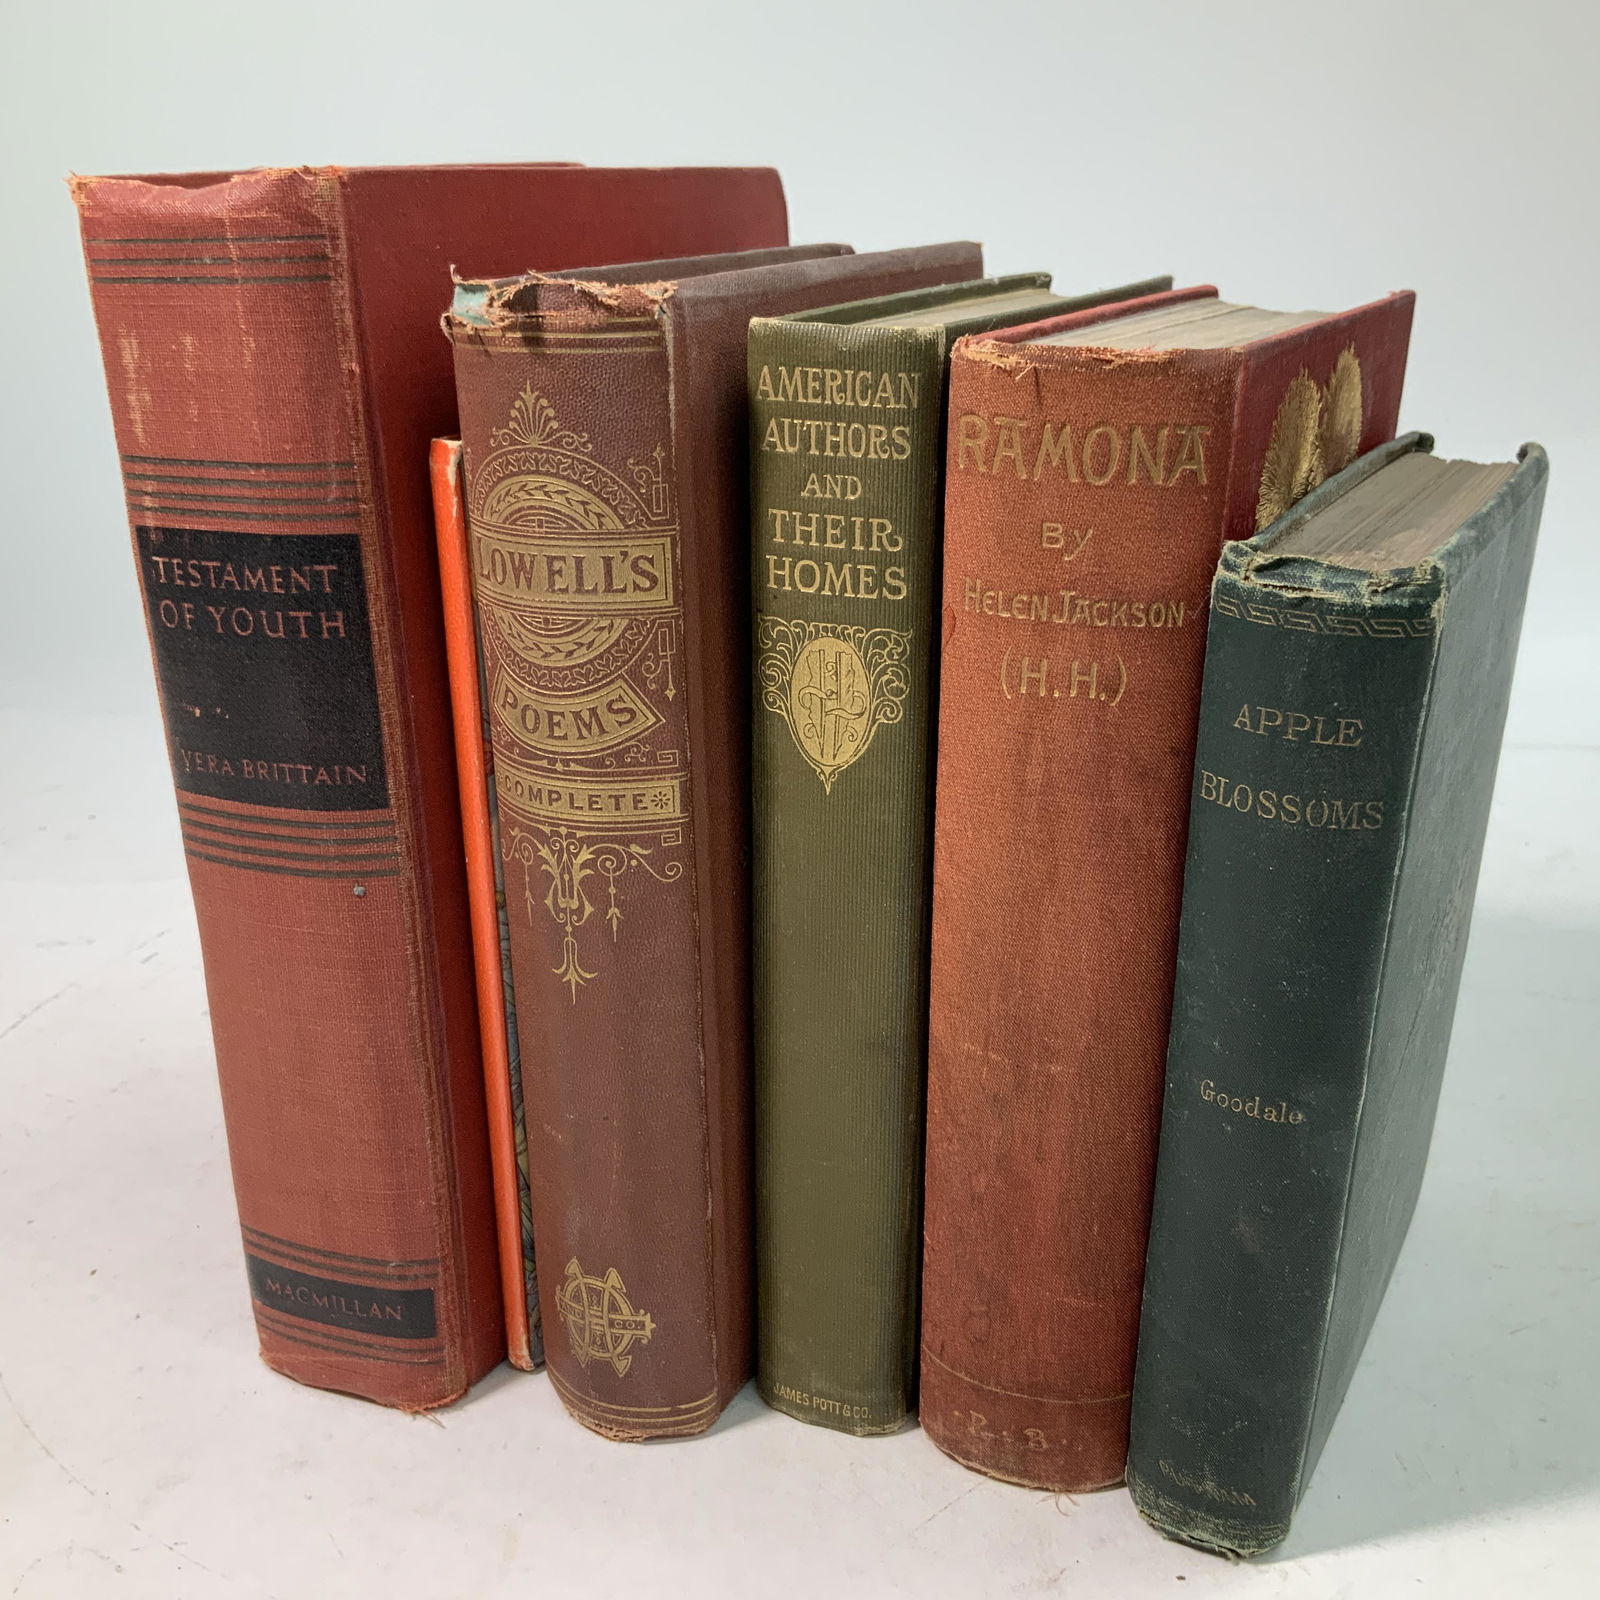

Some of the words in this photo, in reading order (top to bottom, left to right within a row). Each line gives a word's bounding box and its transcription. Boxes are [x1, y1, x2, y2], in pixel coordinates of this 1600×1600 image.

[756, 365, 922, 409] AMERICAN
[762, 417, 911, 460] AUTHORS
[957, 413, 1211, 487] RAMONA
[801, 472, 862, 500] AND
[768, 507, 903, 552] THEIR
[1041, 522, 1093, 561] By
[151, 555, 338, 595] TESTAMENT
[476, 536, 660, 594] LOWELL'S
[765, 555, 908, 601] HOMES
[159, 600, 195, 630] OF
[207, 605, 347, 640] YOUTH
[964, 577, 1048, 622] HELEN
[1052, 590, 1185, 628] JACKSON
[500, 685, 639, 742] POEMS
[1233, 703, 1363, 748] APPLE
[181, 748, 236, 776] VERA
[242, 759, 368, 785] BRITTAIN
[504, 774, 649, 813] COMPLETE
[1199, 769, 1384, 830] BLOSSOMS
[1200, 1079, 1302, 1124] Goodale
[264, 1277, 402, 1321] MACMILLAN
[773, 1382, 810, 1406] JAMES
[812, 1396, 841, 1415] POTT
